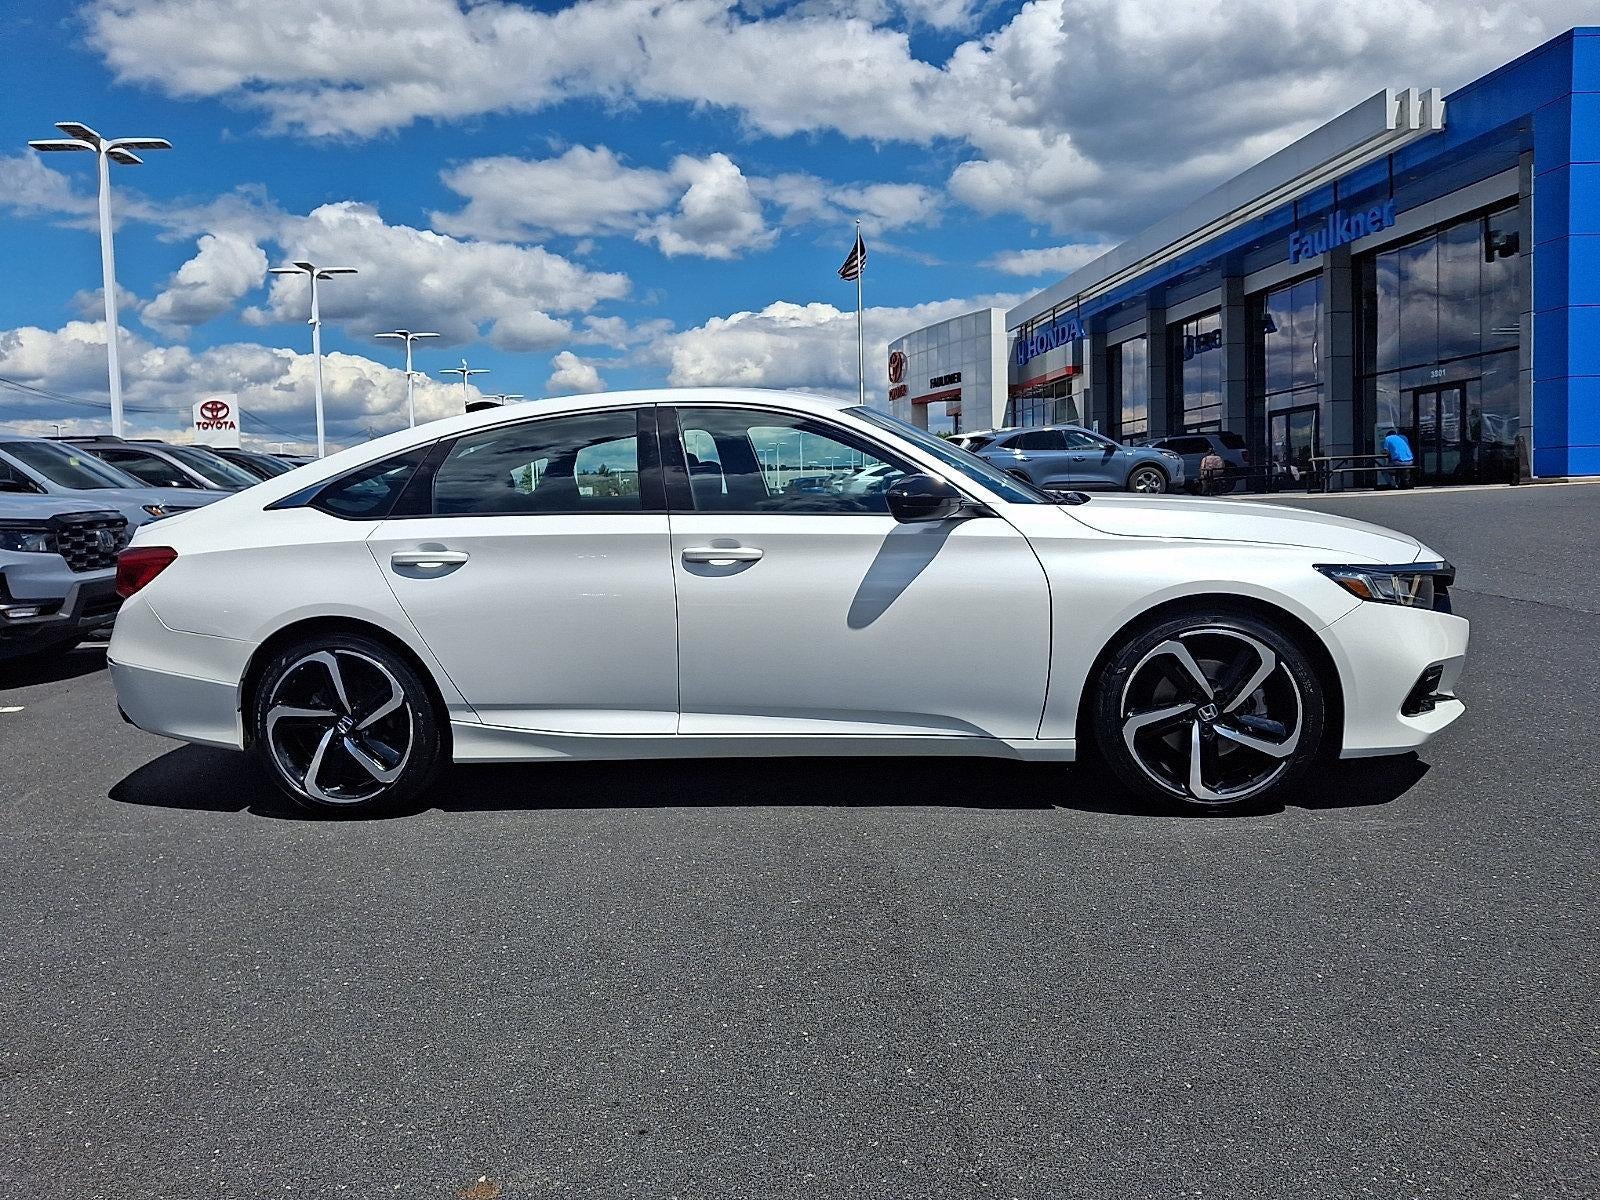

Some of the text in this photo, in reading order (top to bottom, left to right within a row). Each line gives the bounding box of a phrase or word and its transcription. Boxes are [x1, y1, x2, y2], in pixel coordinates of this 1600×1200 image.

[1289, 198, 1395, 264] Faulkner
[1026, 319, 1083, 359] HONDA
[195, 420, 236, 431] TOYOTA
